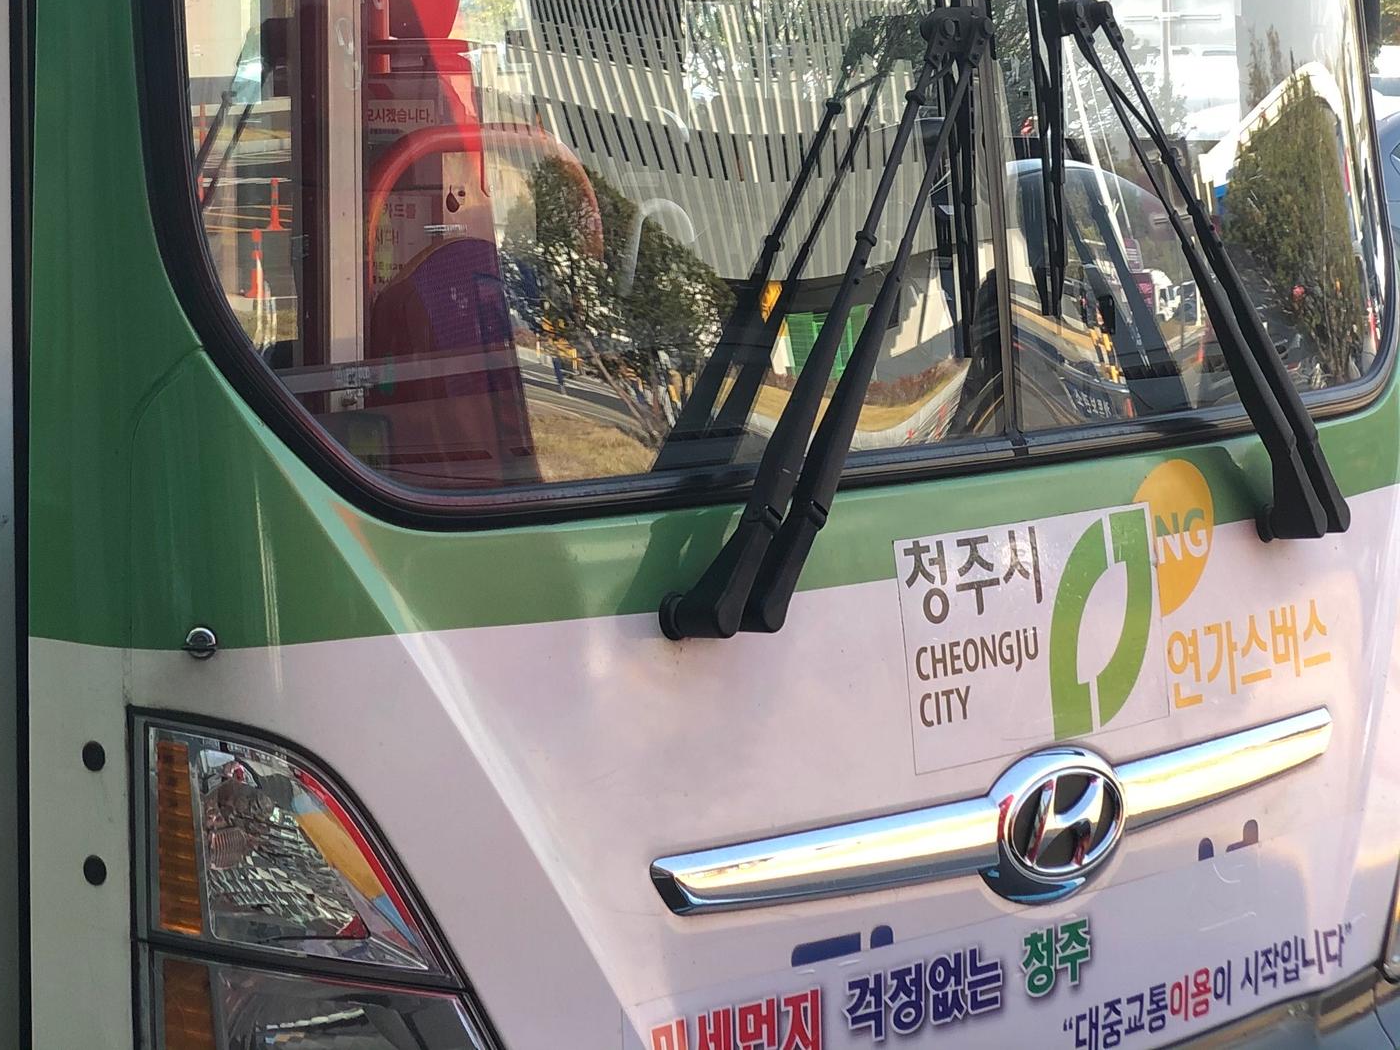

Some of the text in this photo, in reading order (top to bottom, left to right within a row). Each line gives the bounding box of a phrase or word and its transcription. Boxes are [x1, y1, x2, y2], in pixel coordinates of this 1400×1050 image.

[903, 525, 1043, 625] 청주시
[915, 626, 1039, 682] CHEONGJU
[1166, 599, 1332, 710] 연가스버스
[919, 685, 971, 728] CITY
[846, 947, 1002, 1040] 걱정없는
[1021, 918, 1091, 996] 청주
